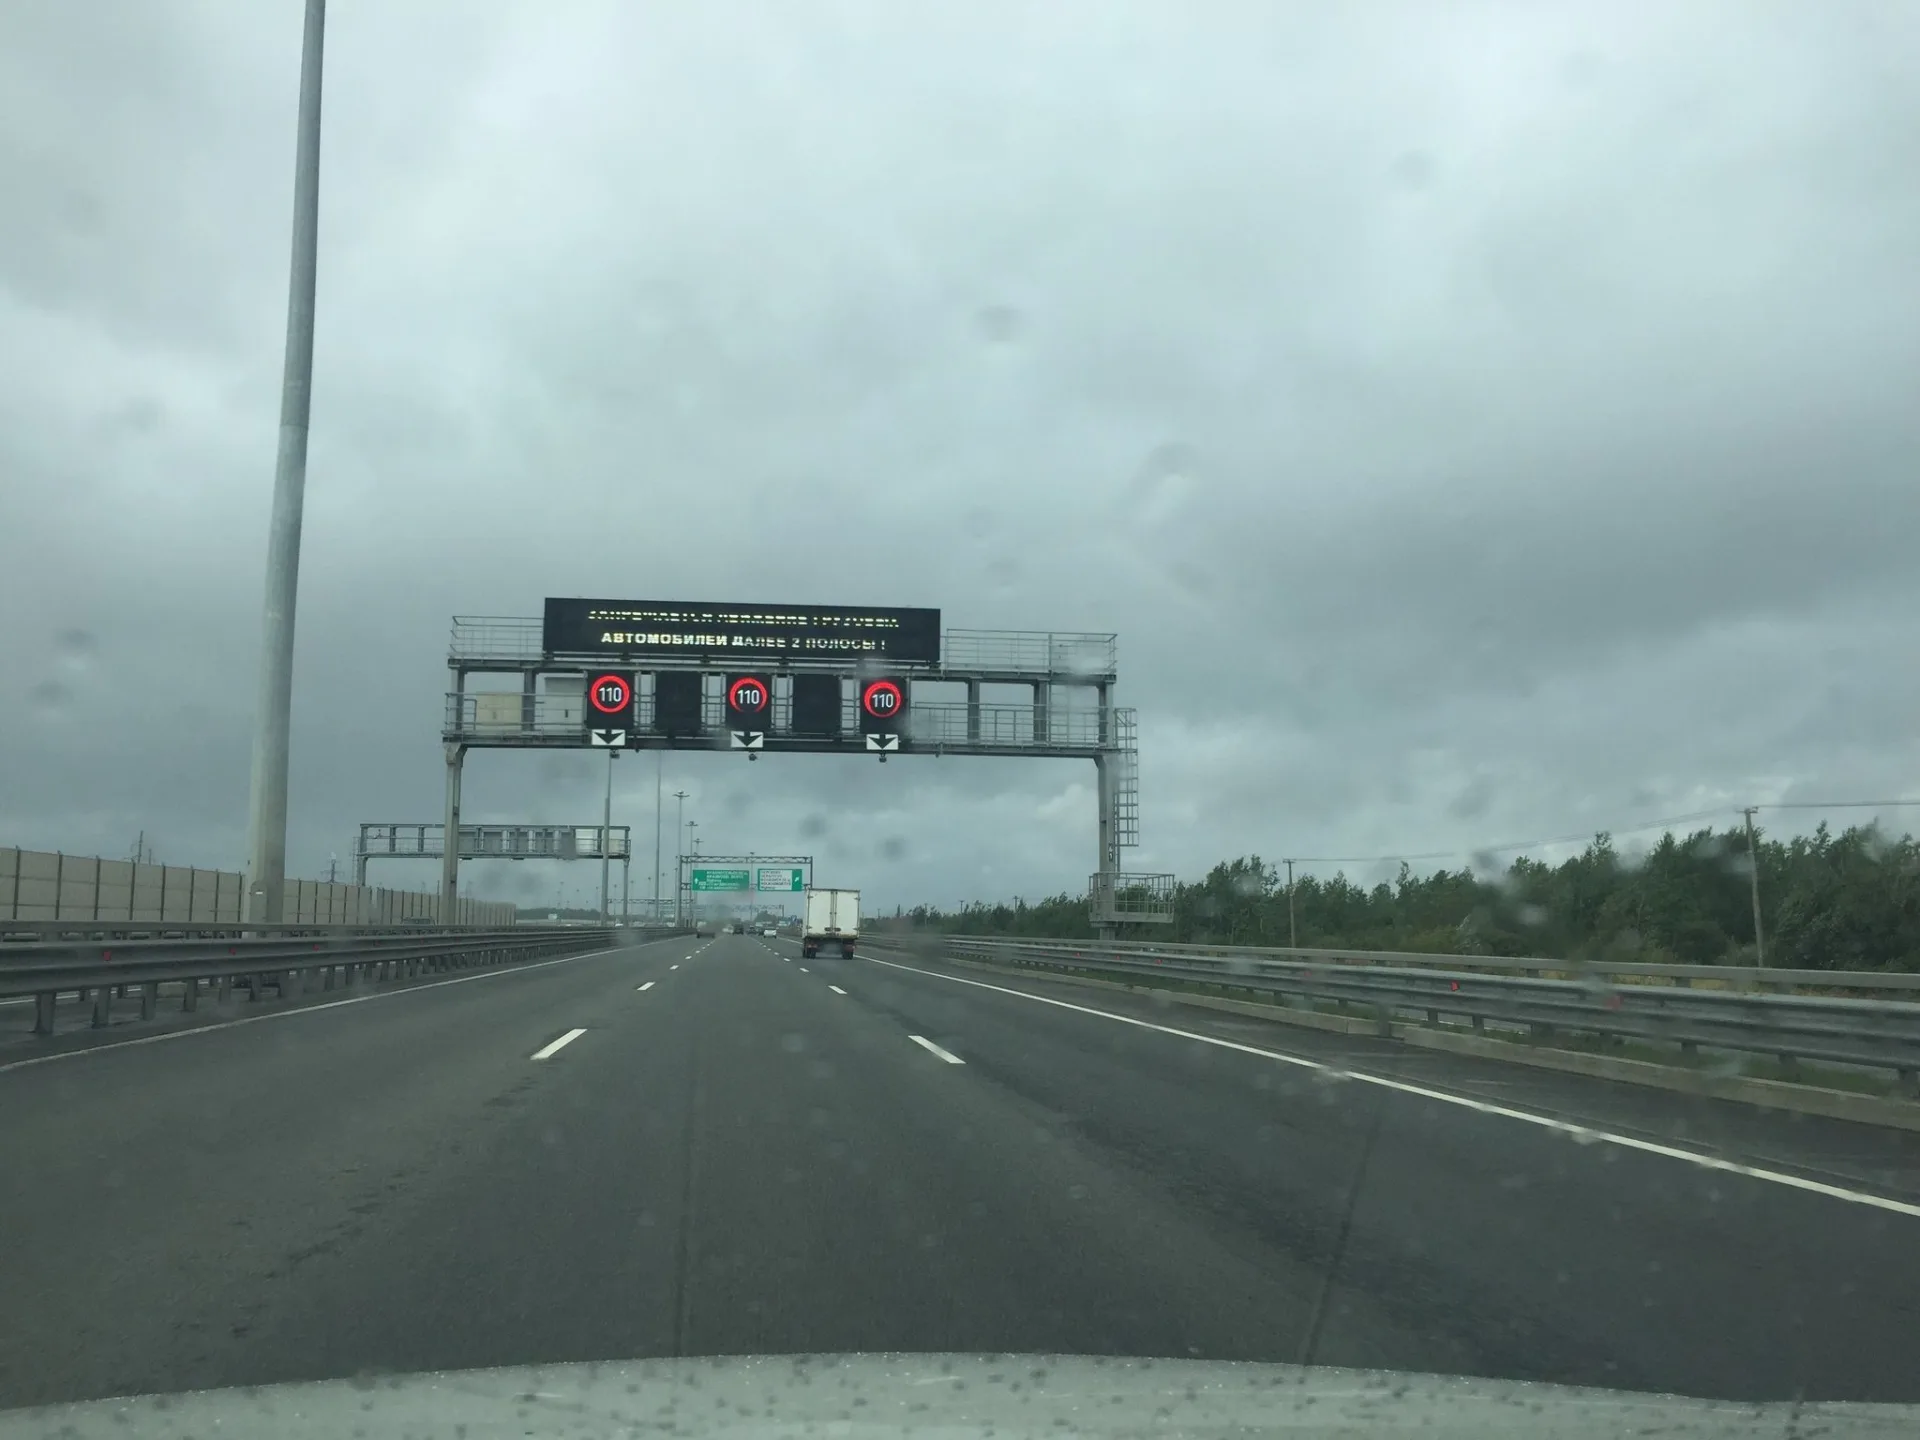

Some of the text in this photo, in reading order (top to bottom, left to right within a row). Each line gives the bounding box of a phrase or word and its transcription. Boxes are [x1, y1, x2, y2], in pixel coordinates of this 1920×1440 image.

[791, 637, 800, 648] 2
[599, 687, 623, 703] 110
[734, 689, 760, 705] 110
[871, 693, 897, 711] 110
